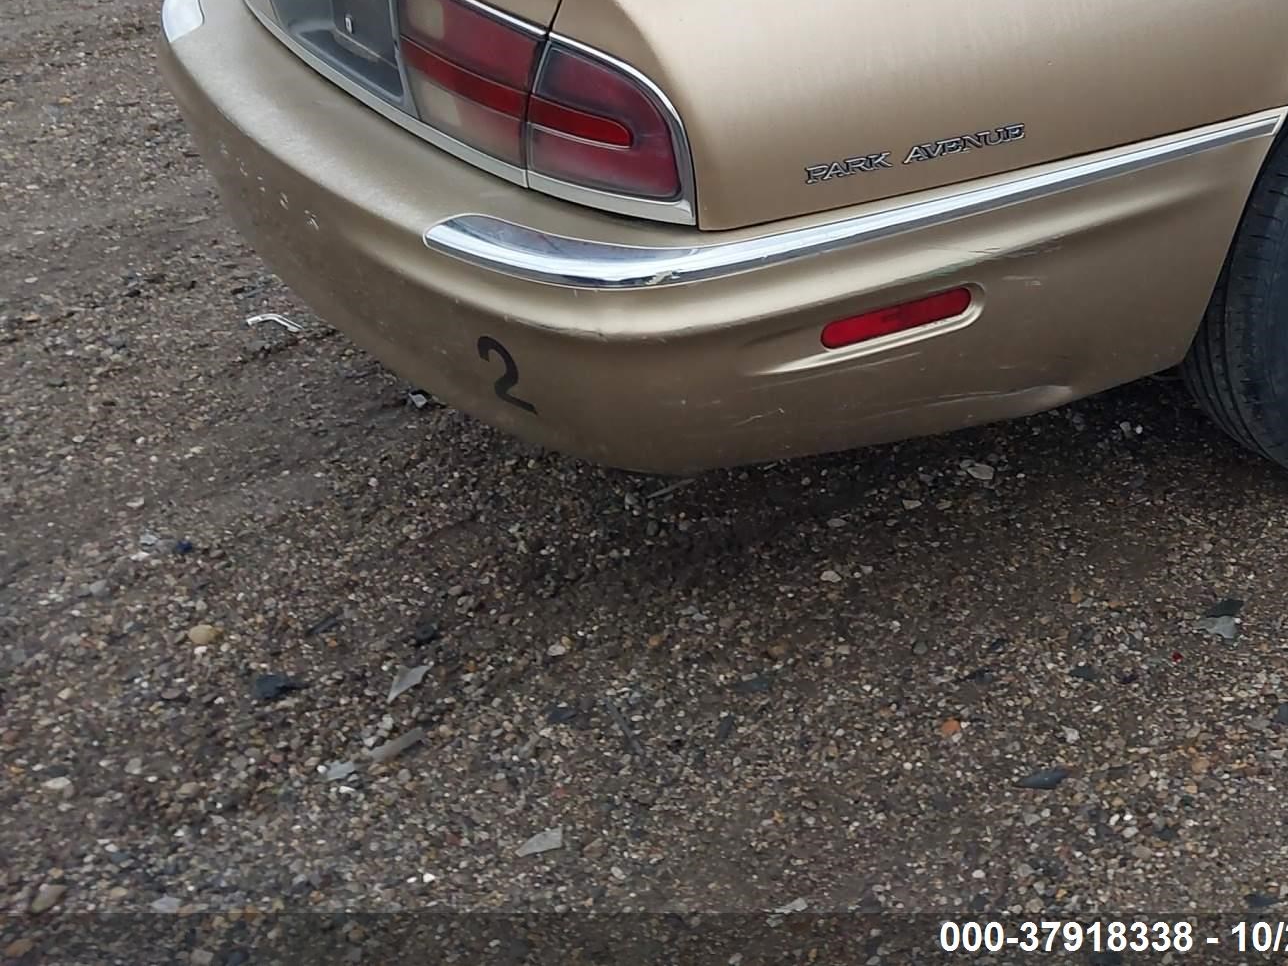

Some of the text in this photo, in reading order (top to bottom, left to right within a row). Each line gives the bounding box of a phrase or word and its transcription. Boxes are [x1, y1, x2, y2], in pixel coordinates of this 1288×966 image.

[805, 123, 1026, 184] PARK AVENUE
[477, 336, 538, 415] 2
